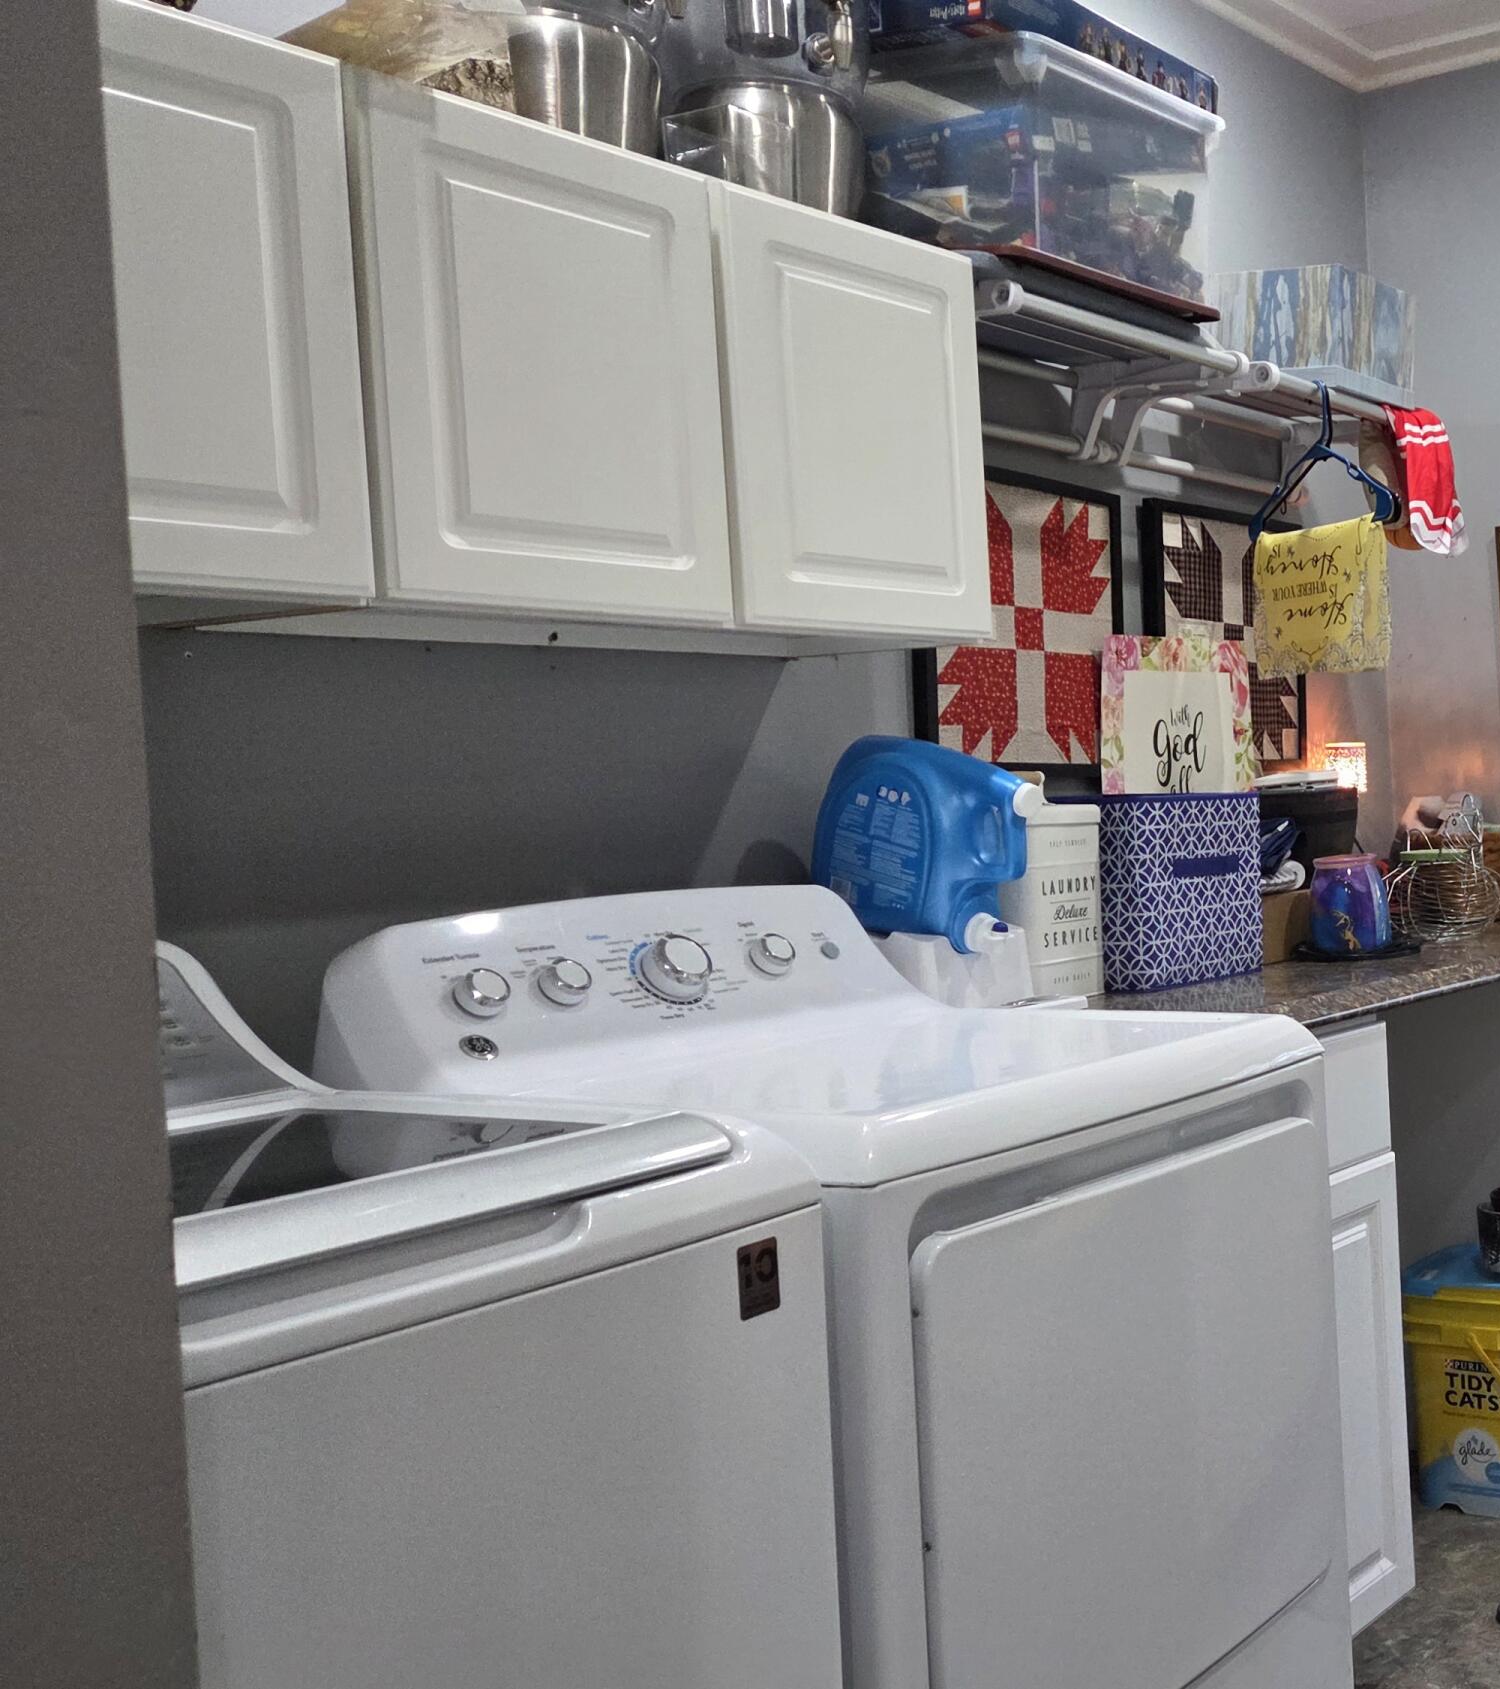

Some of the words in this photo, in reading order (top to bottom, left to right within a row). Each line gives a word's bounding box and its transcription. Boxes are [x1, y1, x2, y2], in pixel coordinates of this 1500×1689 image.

[1271, 585, 1297, 601] YOUR
[1296, 580, 1328, 596] WHERE
[1284, 593, 1354, 630] Home
[1041, 876, 1097, 897] LAUNDRY
[1053, 904, 1089, 921] Deluxe
[1043, 926, 1098, 949] SERVICE
[1454, 1360, 1490, 1372] PURIN
[1445, 1372, 1496, 1393] TIDY
[1445, 1390, 1500, 1412] CATS
[1459, 1440, 1496, 1465] glade
